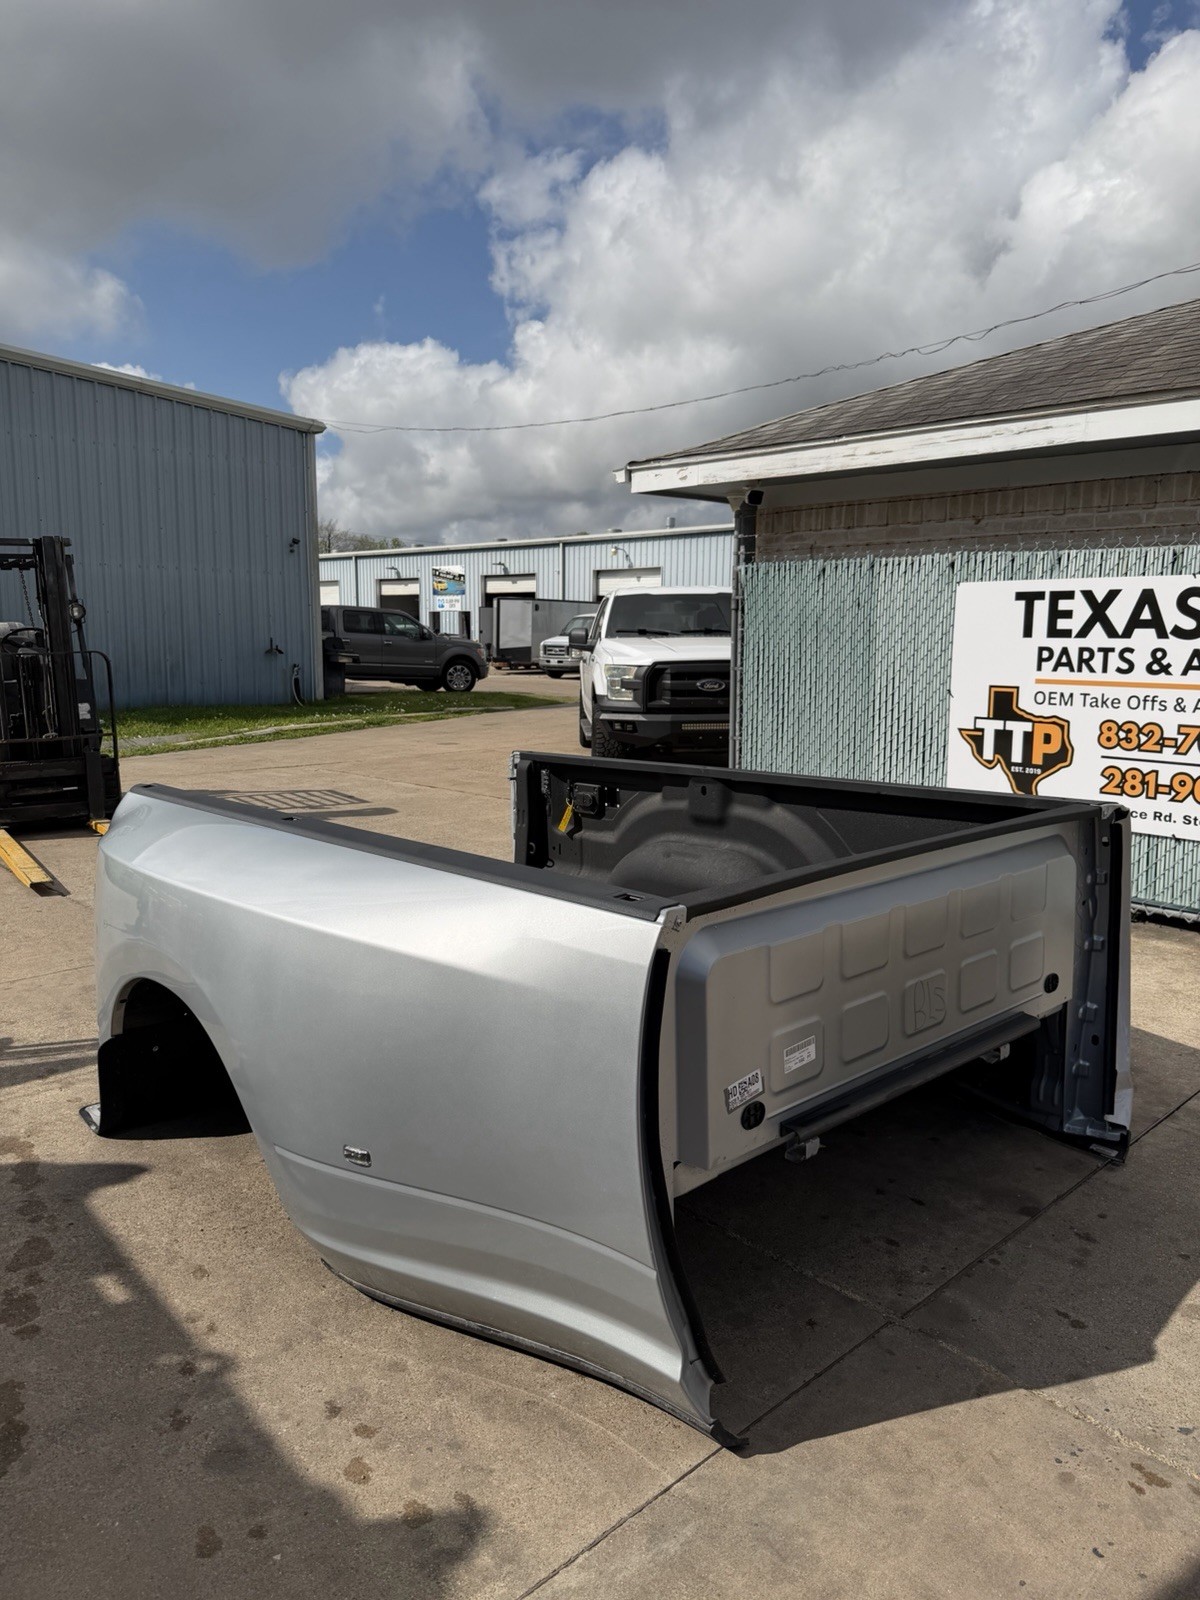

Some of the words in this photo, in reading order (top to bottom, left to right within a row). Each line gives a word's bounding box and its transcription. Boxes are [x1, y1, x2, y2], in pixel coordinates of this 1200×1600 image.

[1015, 586, 1200, 640] TEXAS
[1036, 646, 1135, 675] PARTS
[1145, 648, 1173, 676] &
[1034, 691, 1074, 707] OEM
[1080, 692, 1121, 709] Take
[1127, 695, 1167, 712] Offs
[1173, 697, 1186, 713] &
[975, 717, 1062, 766] TTP
[1098, 719, 1200, 756] 832-7
[1011, 765, 1024, 773] EST.
[1025, 767, 1041, 775] 2019
[1130, 810, 1148, 820] ce
[1153, 811, 1177, 824] Rd.
[1182, 815, 1200, 827] St
